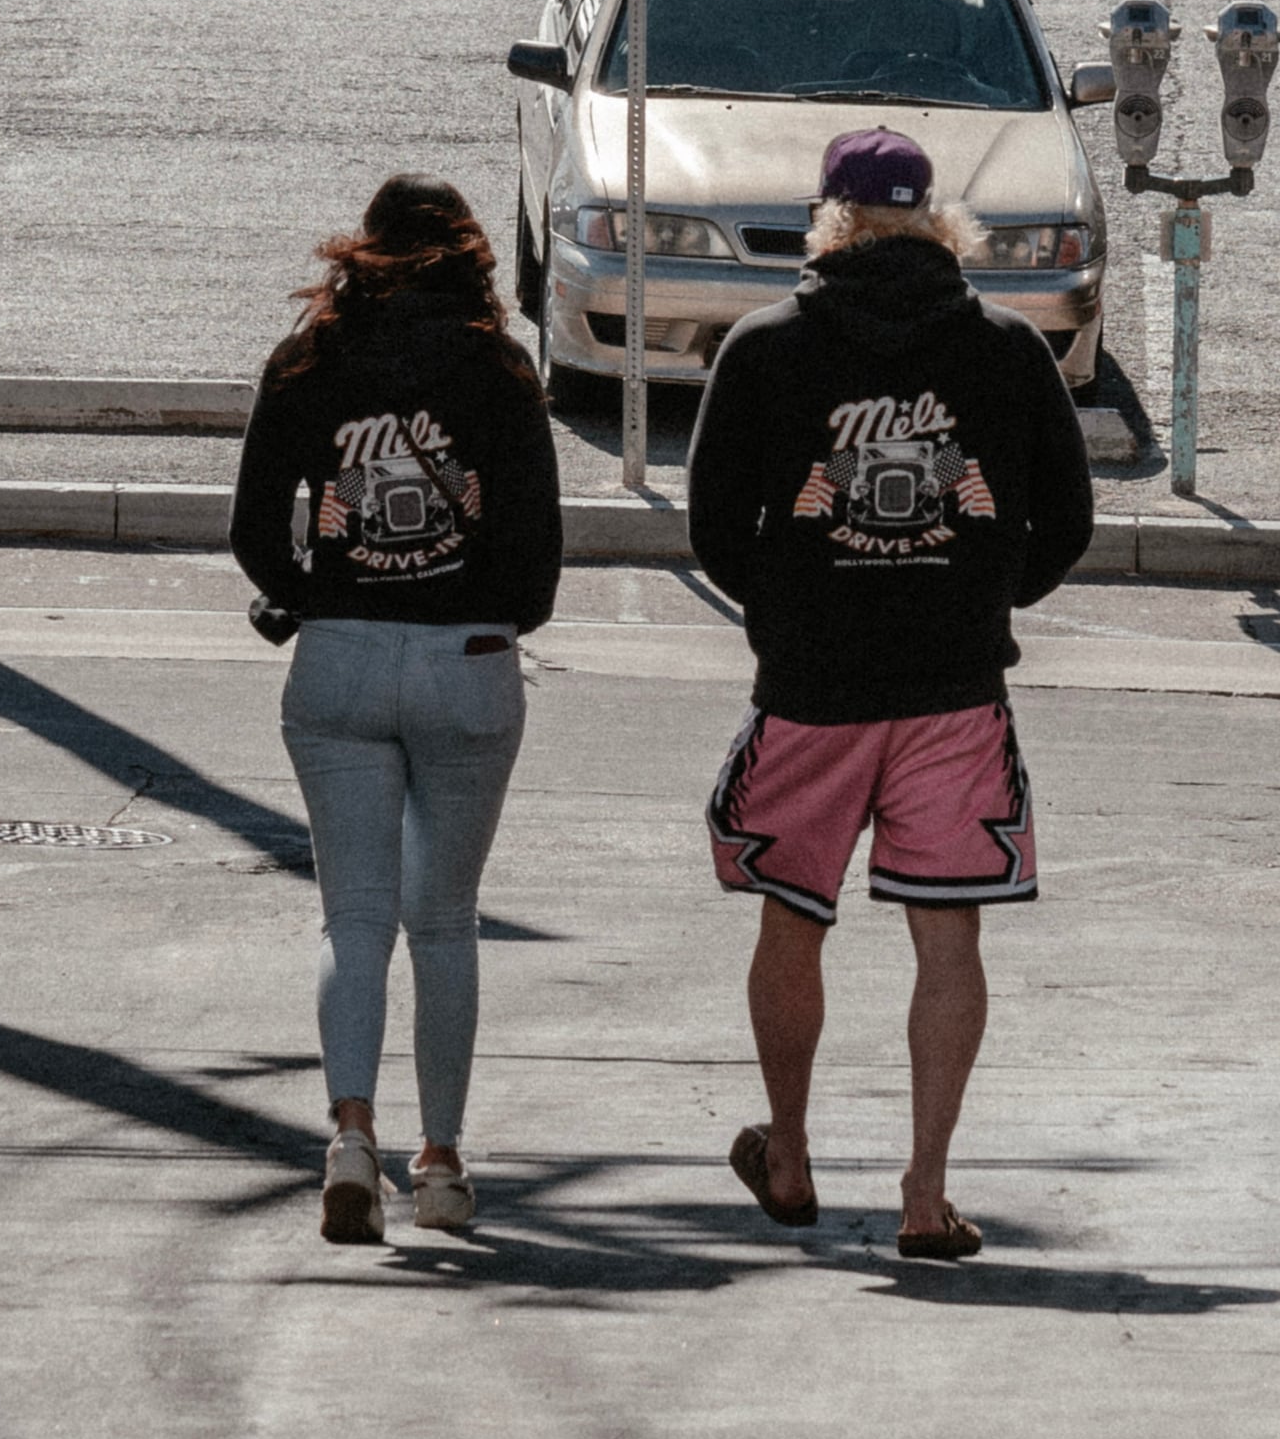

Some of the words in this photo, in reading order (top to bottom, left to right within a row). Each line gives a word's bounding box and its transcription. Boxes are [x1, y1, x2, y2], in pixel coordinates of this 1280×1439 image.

[1153, 49, 1166, 60] 22
[827, 390, 959, 452] Mels
[346, 531, 465, 570] DRIVE-IN
[826, 523, 959, 555] DRIVE-IN
